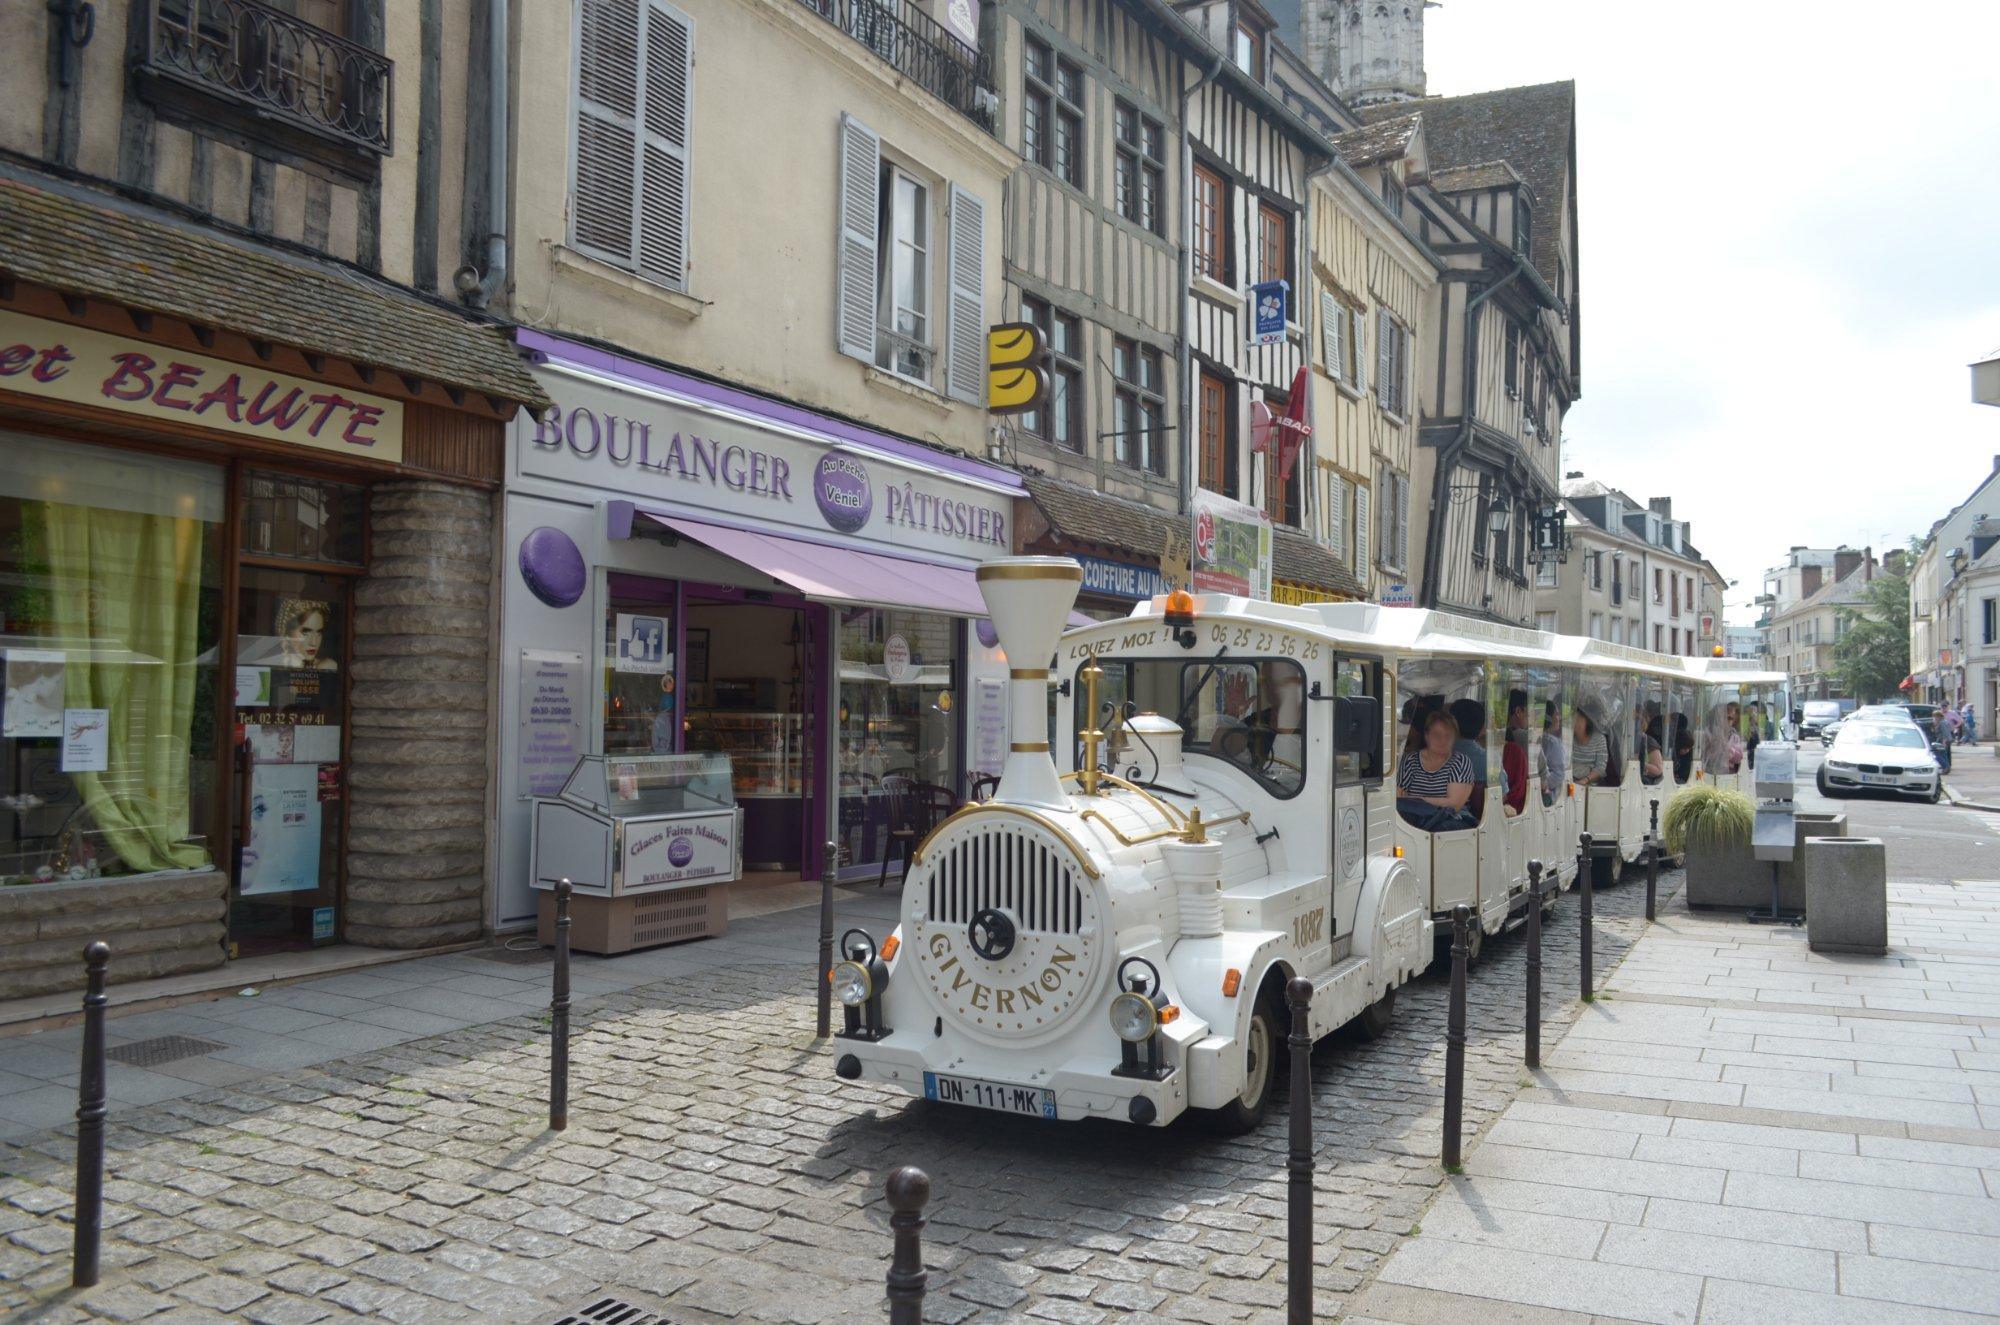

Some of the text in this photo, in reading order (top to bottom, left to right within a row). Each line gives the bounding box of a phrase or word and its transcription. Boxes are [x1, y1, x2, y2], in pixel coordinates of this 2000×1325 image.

[0, 343, 386, 448] et BEAUTE
[533, 402, 1008, 545] BOULANGER PÂTISSIER
[823, 459, 866, 483] Au Péché
[825, 484, 862, 507] Véniel
[1085, 557, 1135, 594] COIFFURE
[1137, 571, 1150, 596] AU
[1070, 638, 1116, 660] LOUEZ
[1121, 631, 1155, 648] MOI
[1211, 625, 1227, 642] 06
[1233, 628, 1251, 647] 25
[1256, 633, 1273, 652] 23
[1279, 637, 1295, 656] 56
[1303, 641, 1319, 660] 26
[259, 712, 272, 724] 02
[630, 832, 664, 856] Glaces
[666, 825, 693, 838] Faites
[695, 825, 728, 847] Maison
[1292, 905, 1325, 950] 1887
[928, 932, 1077, 1014] GIVERNON
[1043, 1104, 1056, 1118] 27
